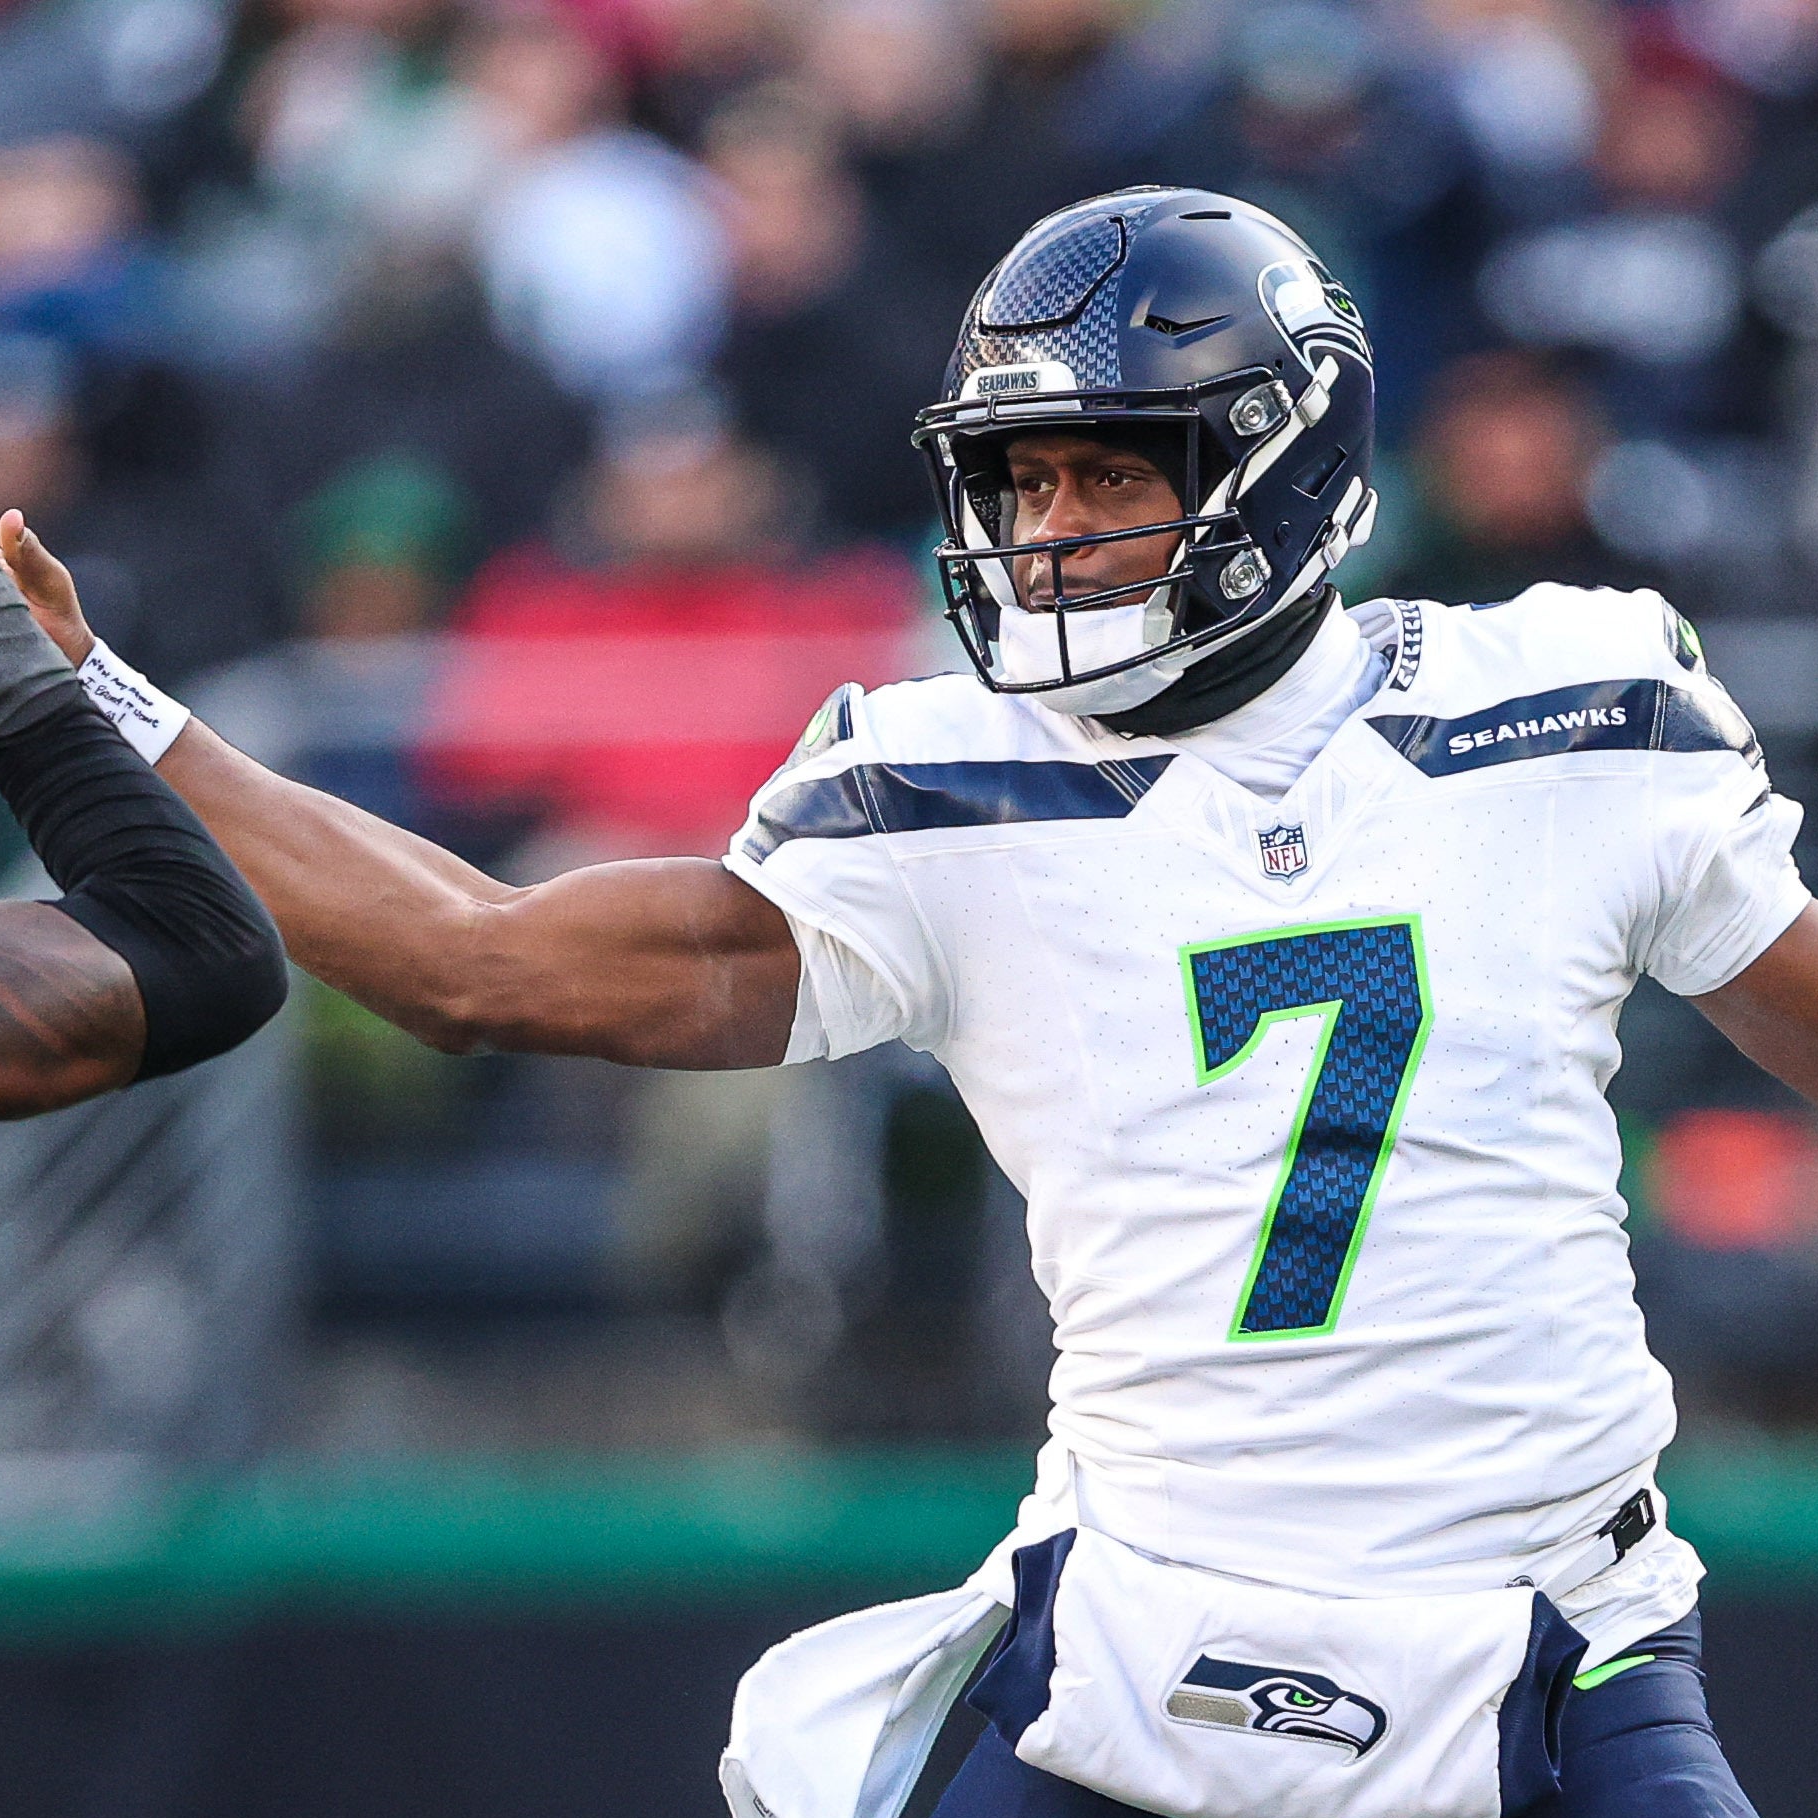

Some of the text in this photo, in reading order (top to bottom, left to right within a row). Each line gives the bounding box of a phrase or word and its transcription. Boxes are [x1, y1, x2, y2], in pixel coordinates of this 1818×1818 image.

[977, 371, 1037, 394] SEAHAWKS
[1448, 707, 1627, 756] SEAHAWKS
[1266, 846, 1303, 872] NFL
[1179, 914, 1435, 1342] 7
